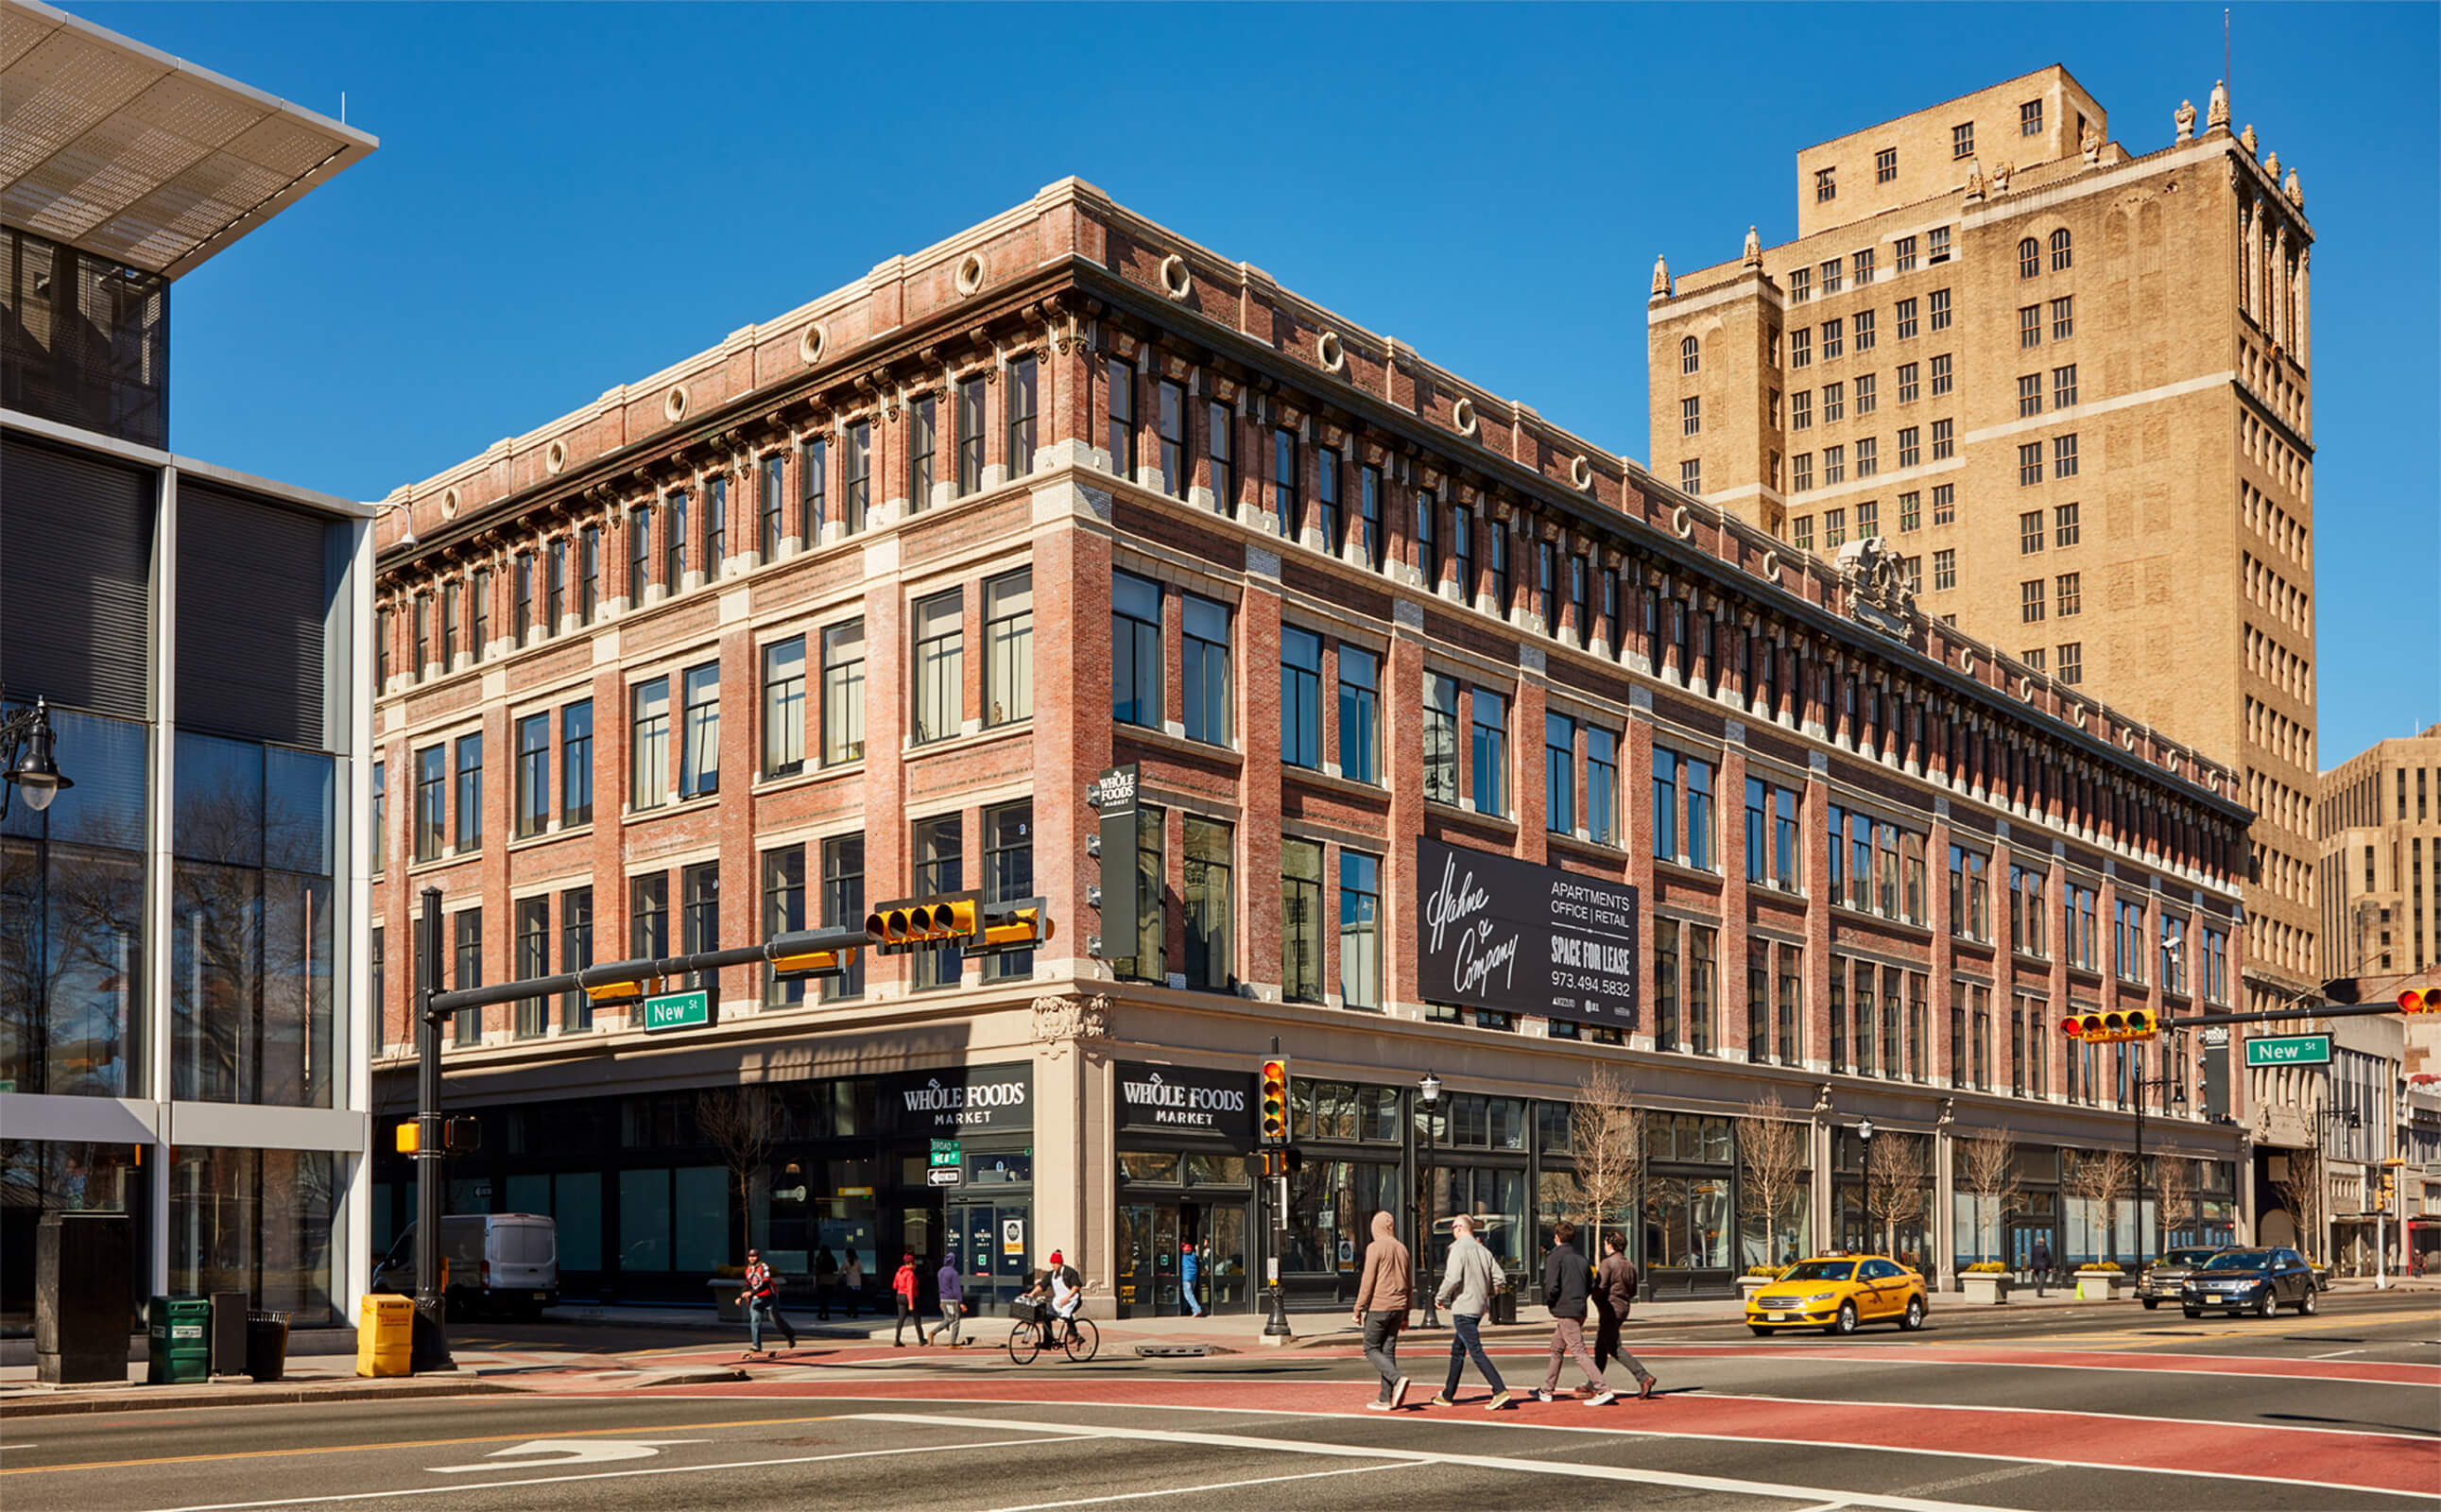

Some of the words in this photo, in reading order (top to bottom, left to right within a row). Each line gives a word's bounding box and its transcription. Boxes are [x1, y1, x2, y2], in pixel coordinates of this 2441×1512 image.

[1099, 773, 1134, 789] WHOLE
[1101, 785, 1134, 802] FOODS
[1426, 851, 1489, 954] Hahne
[1551, 881, 1630, 912] APARTMENTS
[1551, 900, 1589, 920] OFFICE
[1594, 909, 1630, 928] RETAIL
[1453, 928, 1519, 998] Company
[1551, 935, 1581, 969] SPACE
[1583, 941, 1601, 971] FOR
[1602, 945, 1630, 976] LEASE
[1551, 971, 1630, 998] 973.494.5832
[654, 1004, 684, 1022] New
[688, 999, 698, 1010] St
[2259, 1043, 2298, 1059] New
[2305, 1041, 2316, 1051] St
[903, 1084, 963, 1111] WHOLE
[967, 1082, 1025, 1108] FOODS
[1123, 1078, 1186, 1108] WHOLE
[1189, 1087, 1245, 1111] FOODS
[935, 1110, 991, 1125] MARKET
[1156, 1110, 1213, 1125] MARKET
